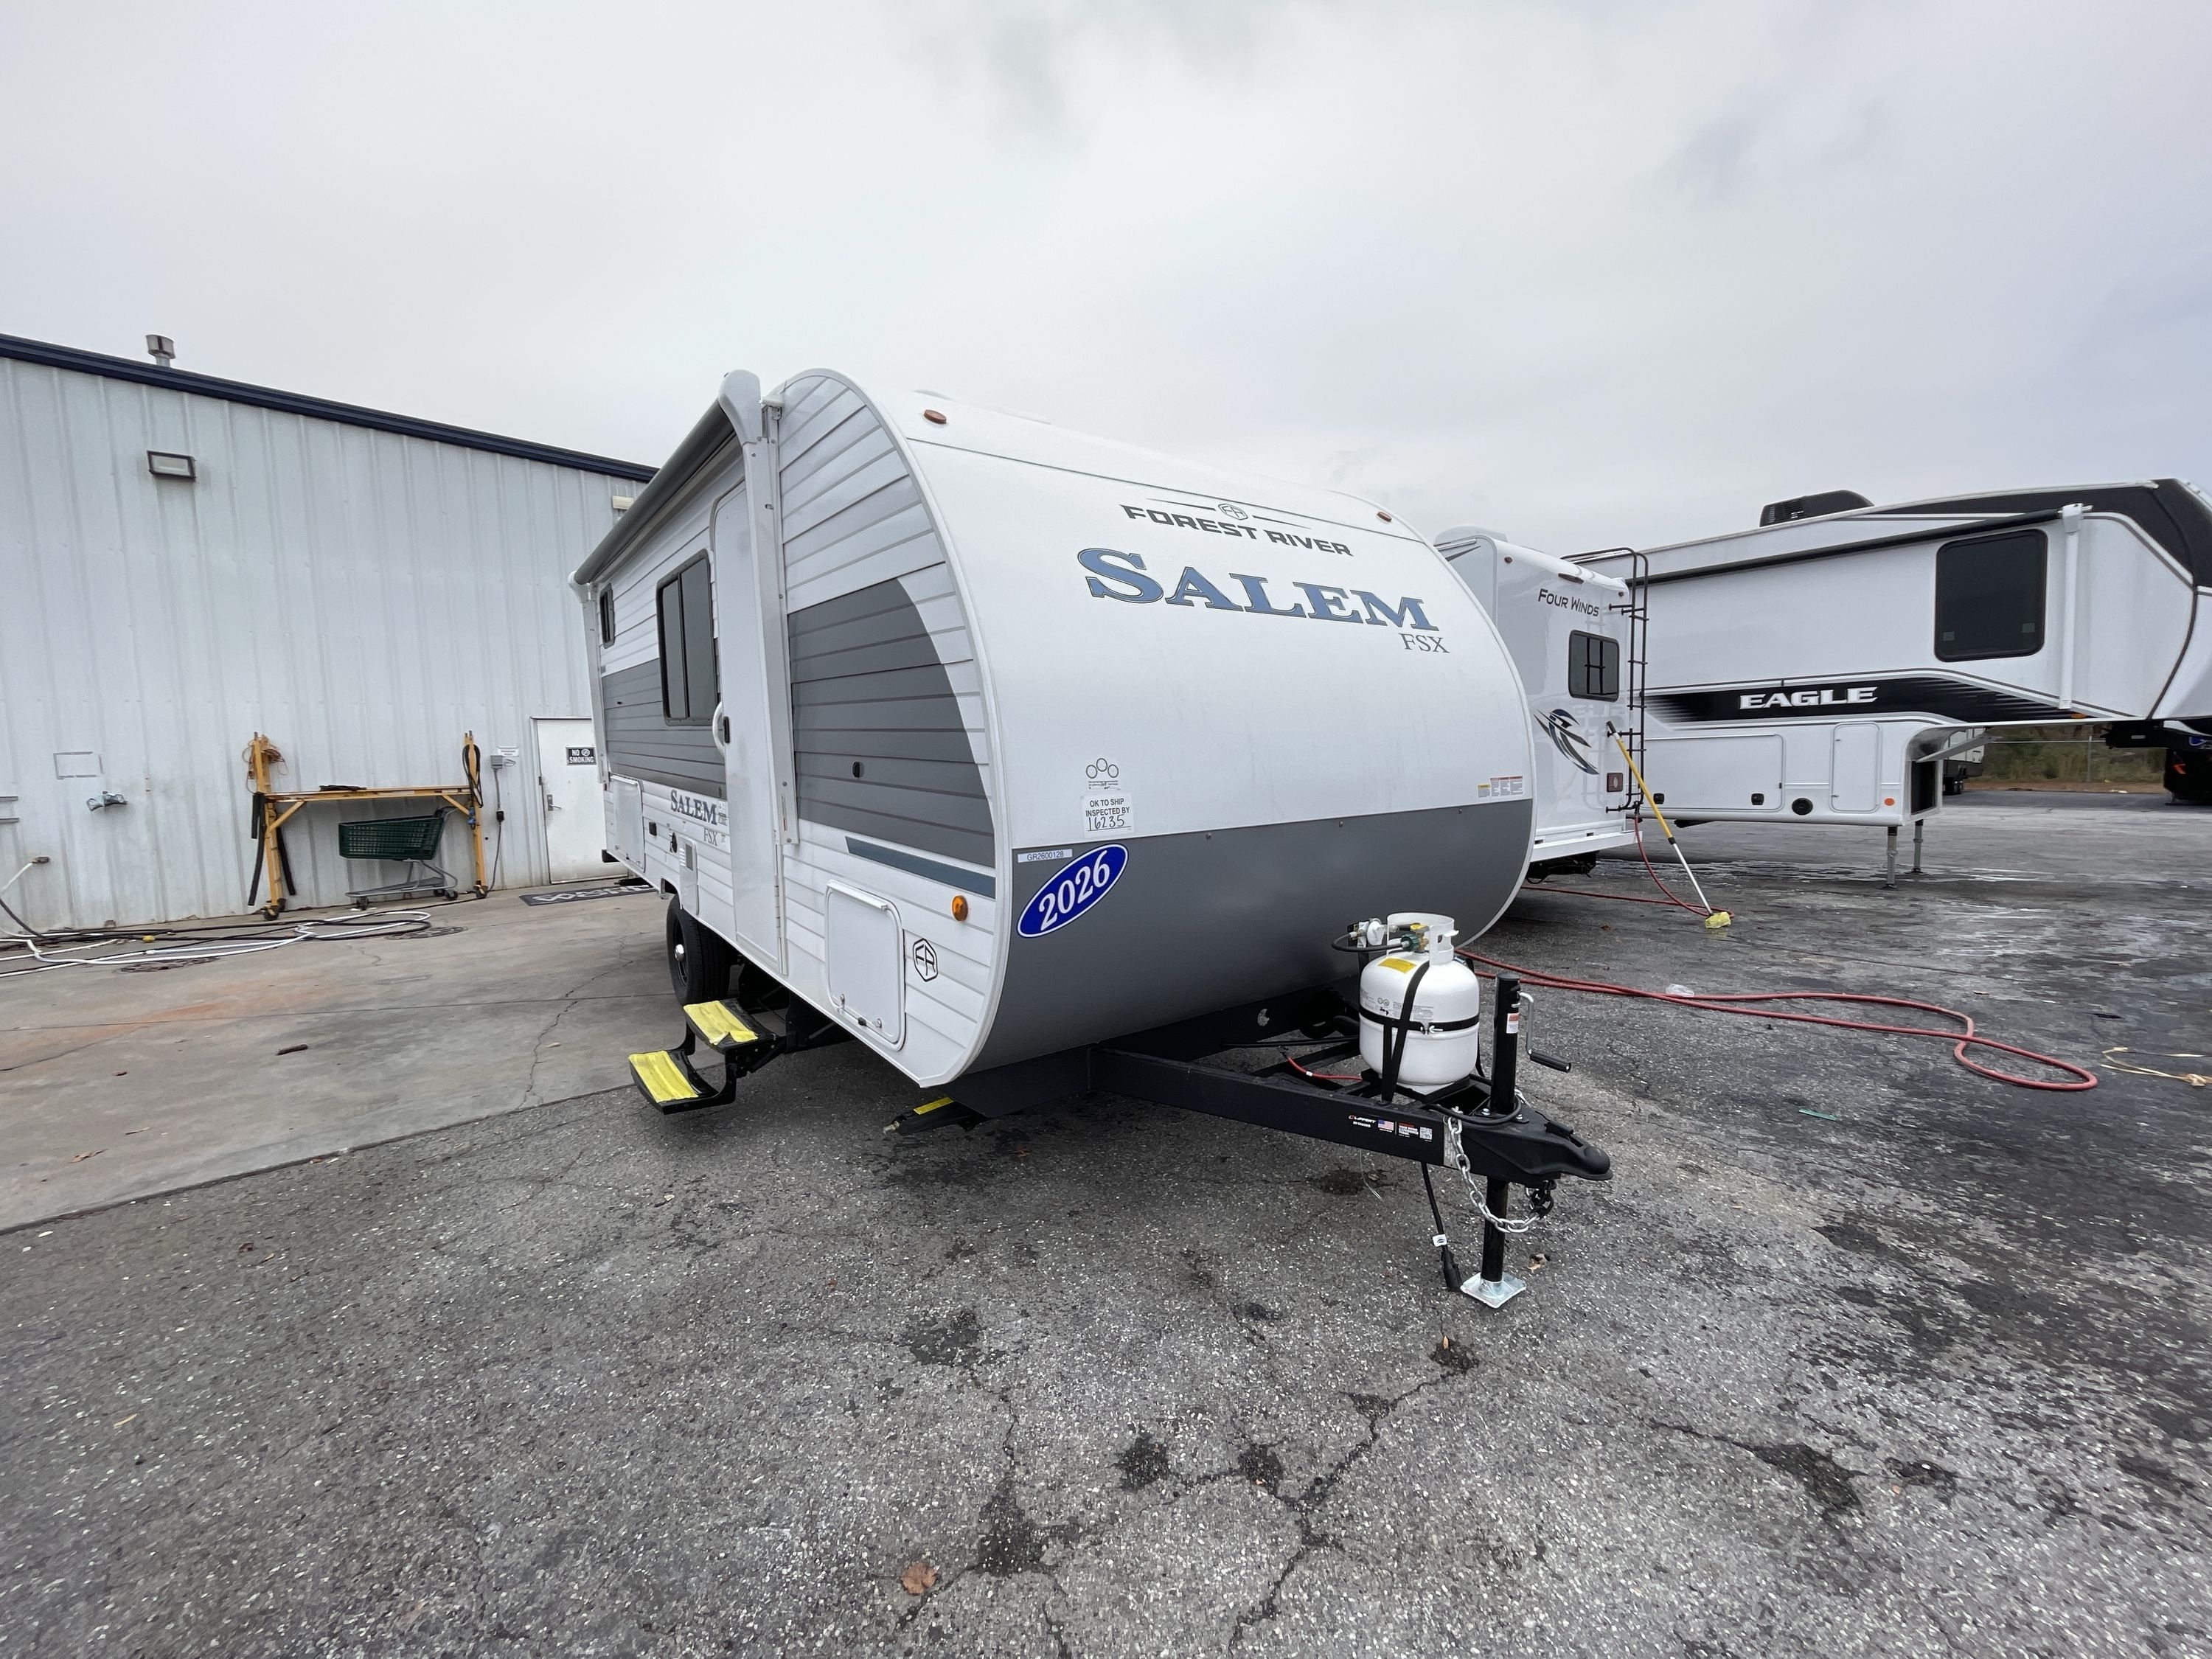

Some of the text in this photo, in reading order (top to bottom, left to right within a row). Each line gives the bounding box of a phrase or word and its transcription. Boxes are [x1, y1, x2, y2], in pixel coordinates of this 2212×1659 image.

[1119, 504, 1354, 557] FOREST RIVER
[1077, 548, 1440, 632] SALEM
[1538, 588, 1599, 616] FOUR WINDS
[1398, 633, 1450, 653] FSX
[1739, 686, 1878, 709] EAGLE
[670, 789, 717, 826] SALEM
[1085, 807, 1120, 817] INSPECTED
[1088, 814, 1125, 831] 16235
[703, 827, 718, 846] FSX
[1026, 851, 1064, 861] GR2600128
[1038, 849, 1110, 931] 2026
